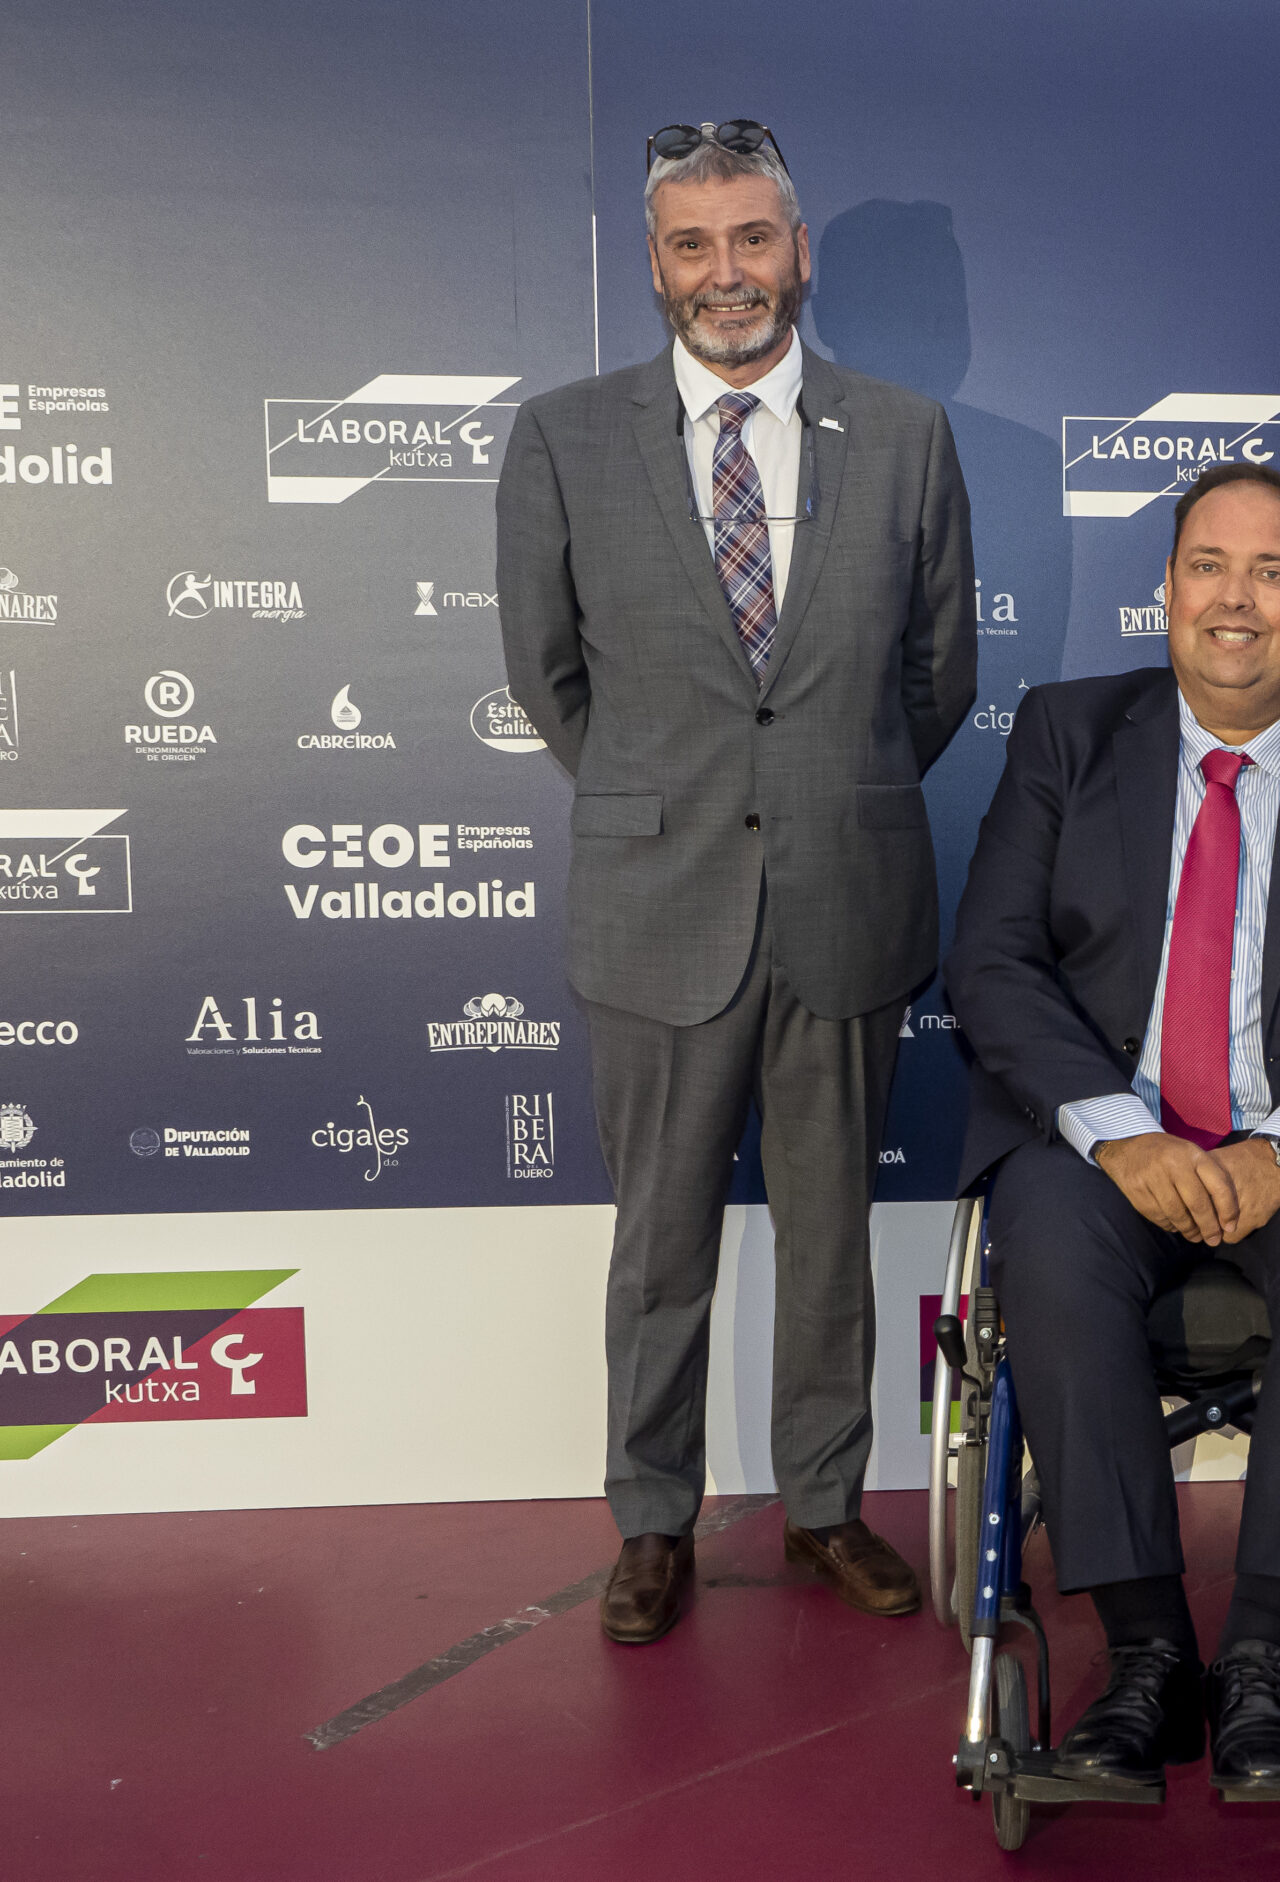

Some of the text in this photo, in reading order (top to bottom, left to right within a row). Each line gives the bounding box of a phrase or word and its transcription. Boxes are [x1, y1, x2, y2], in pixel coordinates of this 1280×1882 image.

[28, 385, 106, 400] Empresas
[29, 399, 109, 414] Españolas
[298, 419, 451, 445] LABORAL
[1093, 436, 1235, 461] LABORAL
[390, 449, 452, 467] kutxa
[213, 581, 303, 609] INTEGRA
[440, 588, 500, 610] max
[125, 725, 217, 743] RUEDA
[135, 746, 207, 755] DENOMINACIÓN
[161, 754, 196, 762] ORIGEN
[457, 824, 532, 840] Empresas
[282, 824, 450, 868] CEOE
[457, 838, 534, 853] Españolas
[284, 880, 535, 918] Valladolid
[185, 997, 322, 1041] Alia
[0, 1019, 79, 1046] ecco
[427, 1020, 562, 1050] ENTREPINARES
[242, 1047, 287, 1055] Soluciones
[288, 1046, 322, 1054] Técnicas
[50, 1158, 64, 1166] de
[0, 1171, 65, 1188] ladolid
[513, 1168, 555, 1179] DUERO
[0, 1336, 199, 1375] ABORAL
[105, 1378, 201, 1404] kutxa
